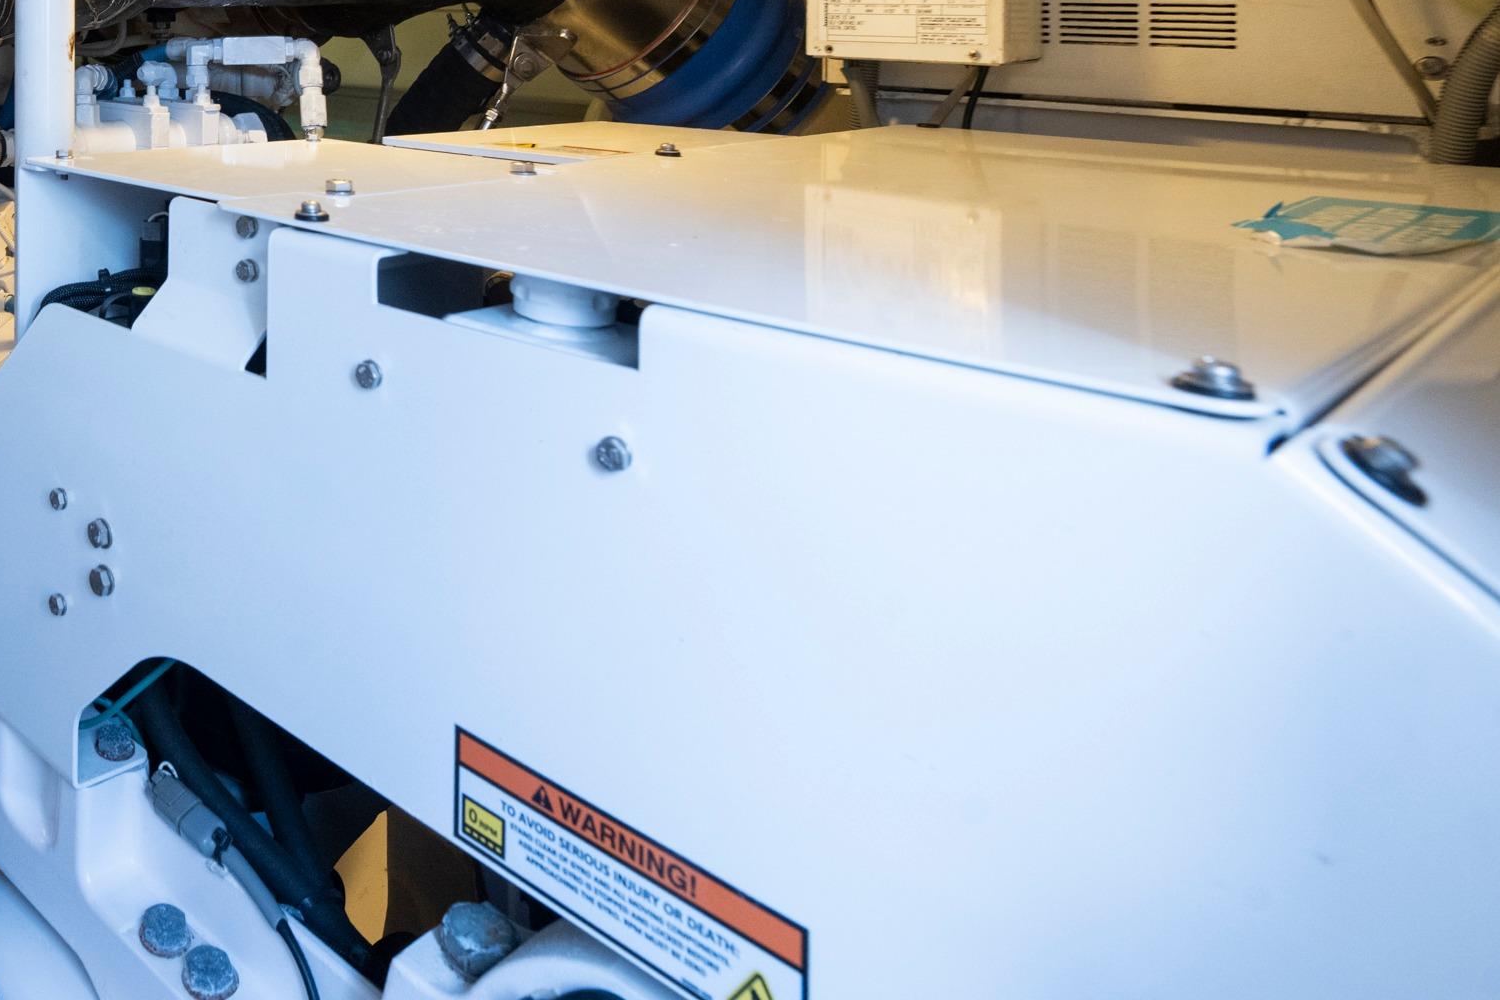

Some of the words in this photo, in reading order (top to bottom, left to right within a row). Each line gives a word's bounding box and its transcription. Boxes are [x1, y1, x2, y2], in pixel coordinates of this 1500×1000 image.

[501, 799, 515, 819] TO
[518, 810, 555, 843] AVOID
[559, 835, 610, 877] SERIOUS
[613, 869, 660, 909] INJURY
[663, 899, 682, 922] OR
[558, 796, 697, 898] WARNING!
